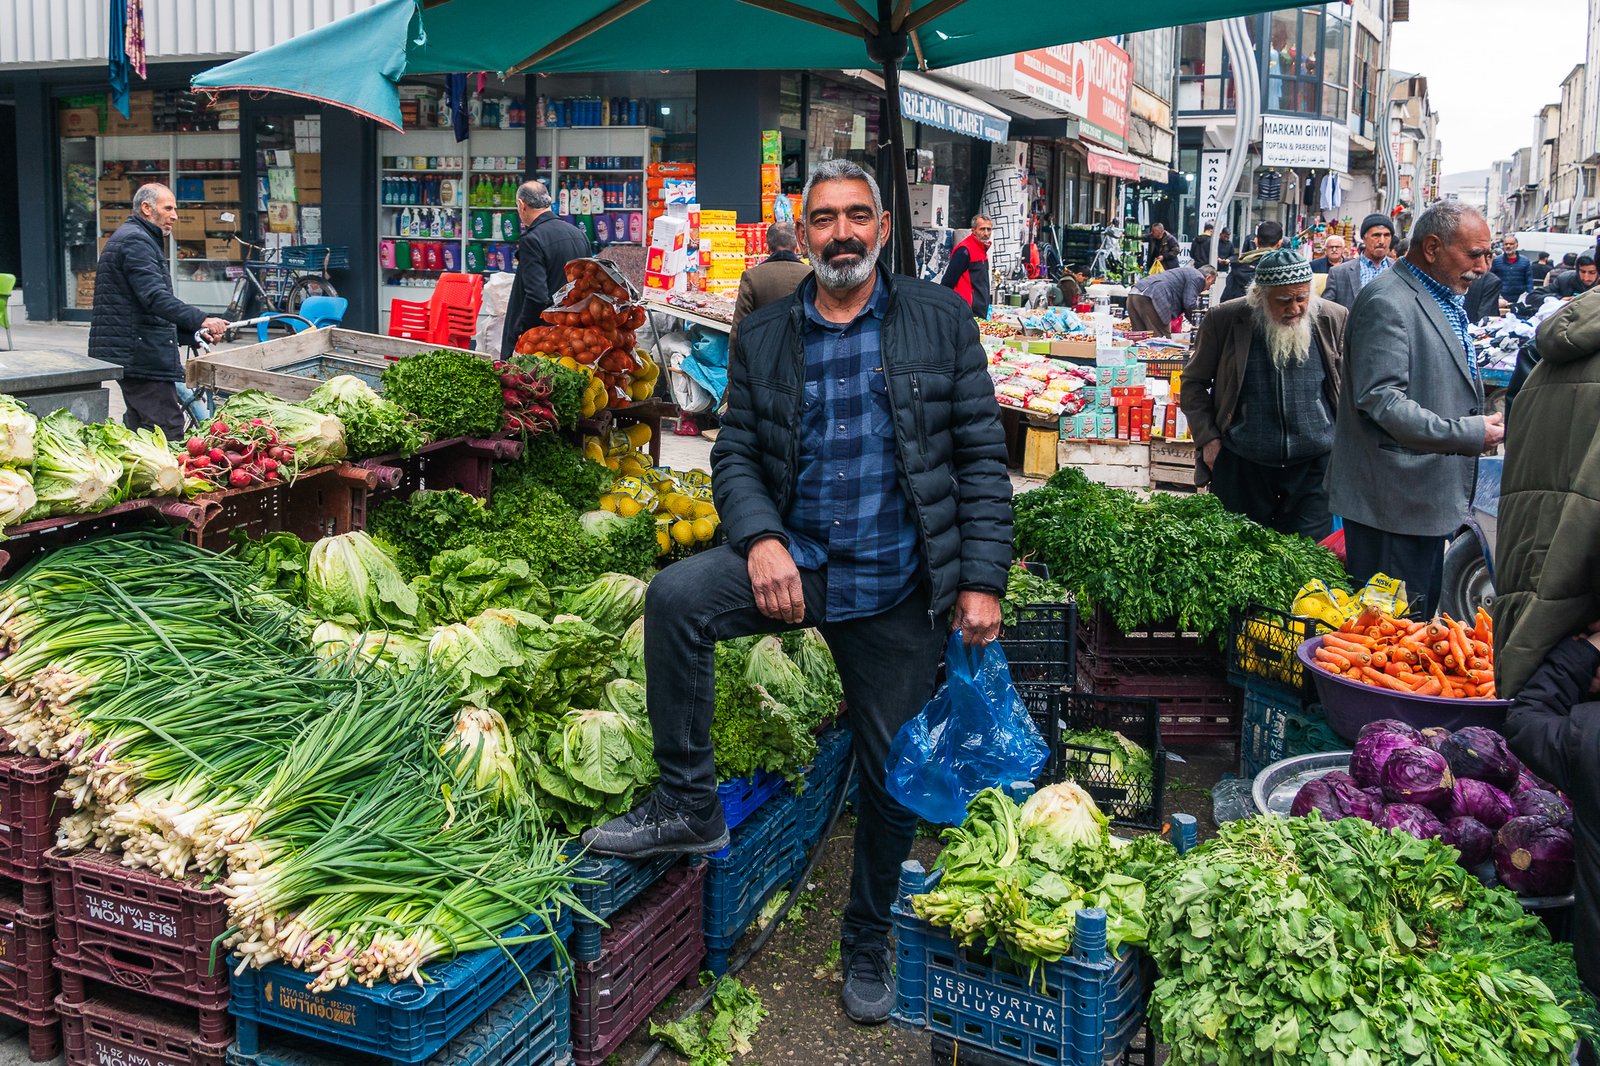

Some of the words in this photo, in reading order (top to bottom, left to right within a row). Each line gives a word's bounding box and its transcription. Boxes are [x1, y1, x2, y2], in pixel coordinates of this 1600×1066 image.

[1264, 122, 1302, 136] MARKAM
[1265, 141, 1288, 150] TOPTAN
[85, 894, 99, 906] TL
[101, 899, 114, 910] 25
[86, 904, 125, 925] KOM.
[120, 904, 143, 917] VAN
[148, 911, 176, 925] 1-2-3
[95, 1042, 109, 1054] TL
[110, 1047, 123, 1058] 25
